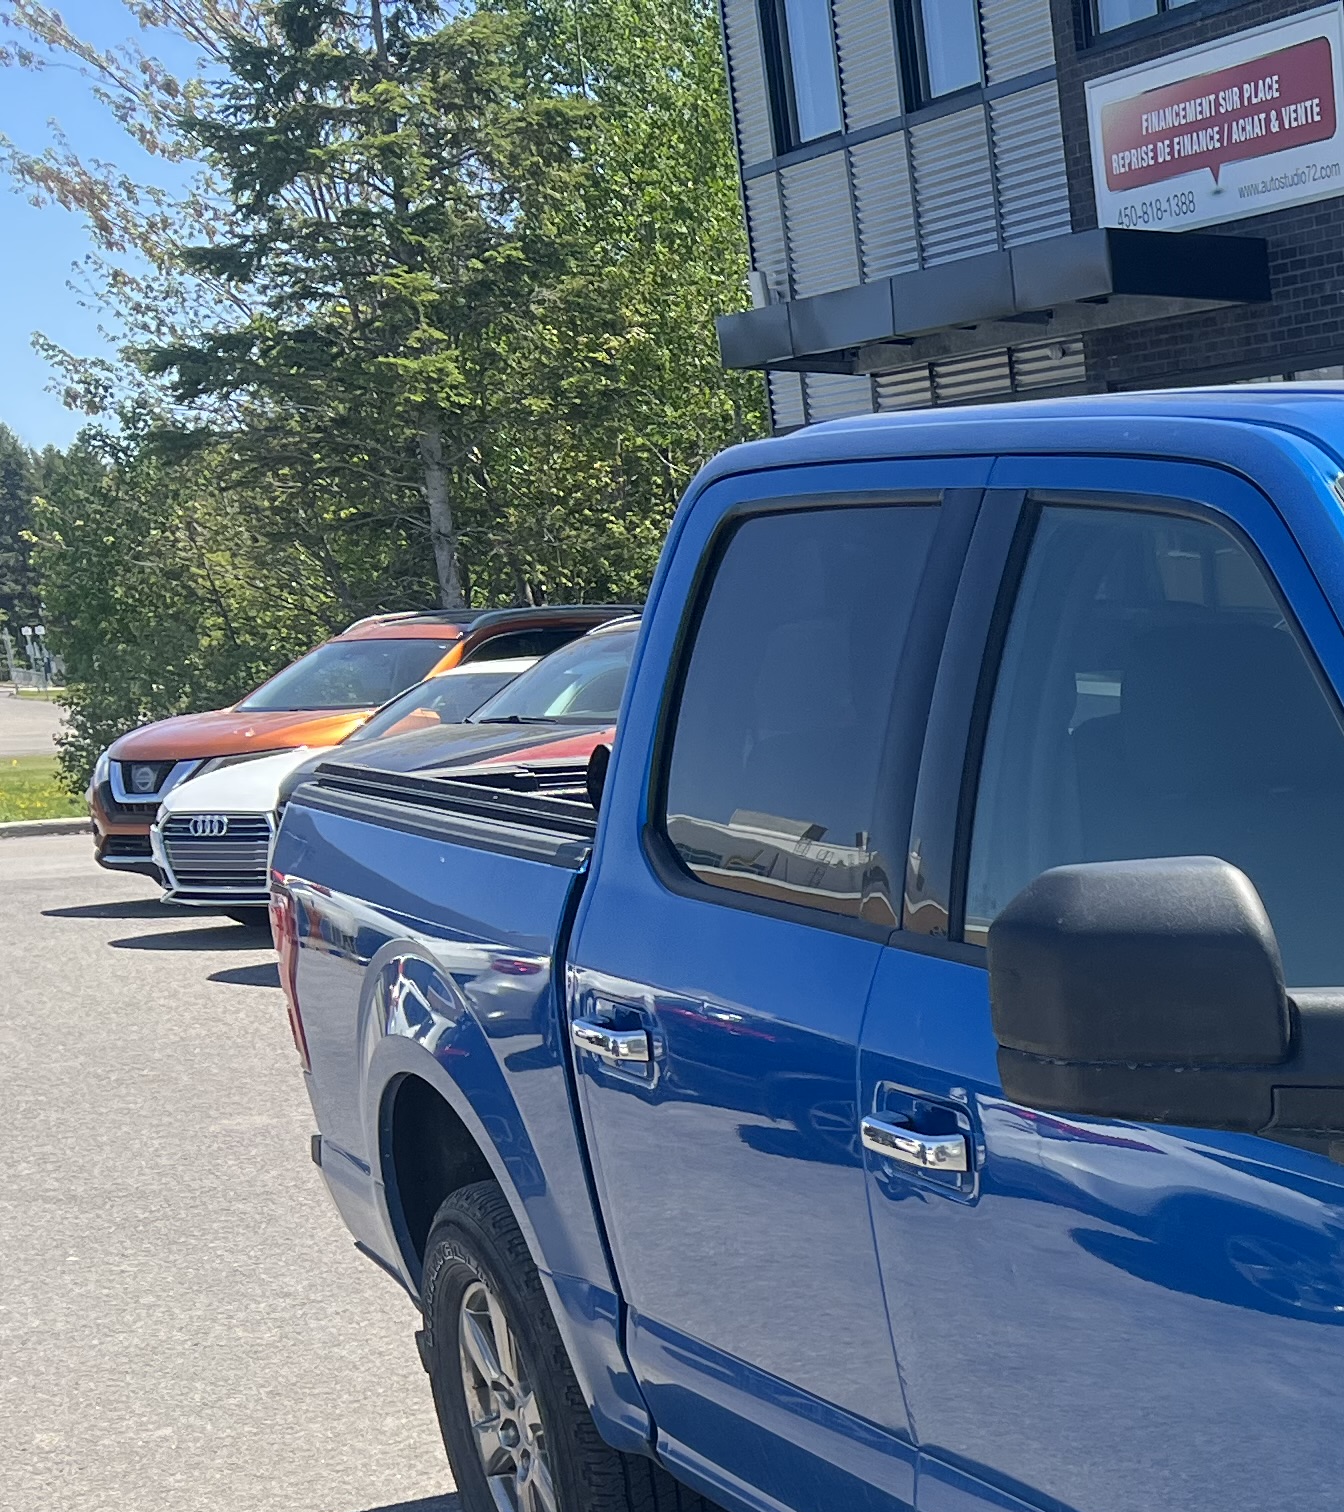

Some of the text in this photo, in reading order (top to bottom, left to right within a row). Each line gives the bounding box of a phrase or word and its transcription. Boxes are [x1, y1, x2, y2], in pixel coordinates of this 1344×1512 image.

[1141, 75, 1280, 135] FINANCEMENT SUR PLACE
[1111, 98, 1321, 175] REPRISE DE FINANCE / ACHAT & VENTE
[1237, 162, 1341, 199] www.autostudio72.com
[1117, 191, 1196, 229] 450-818-1388
